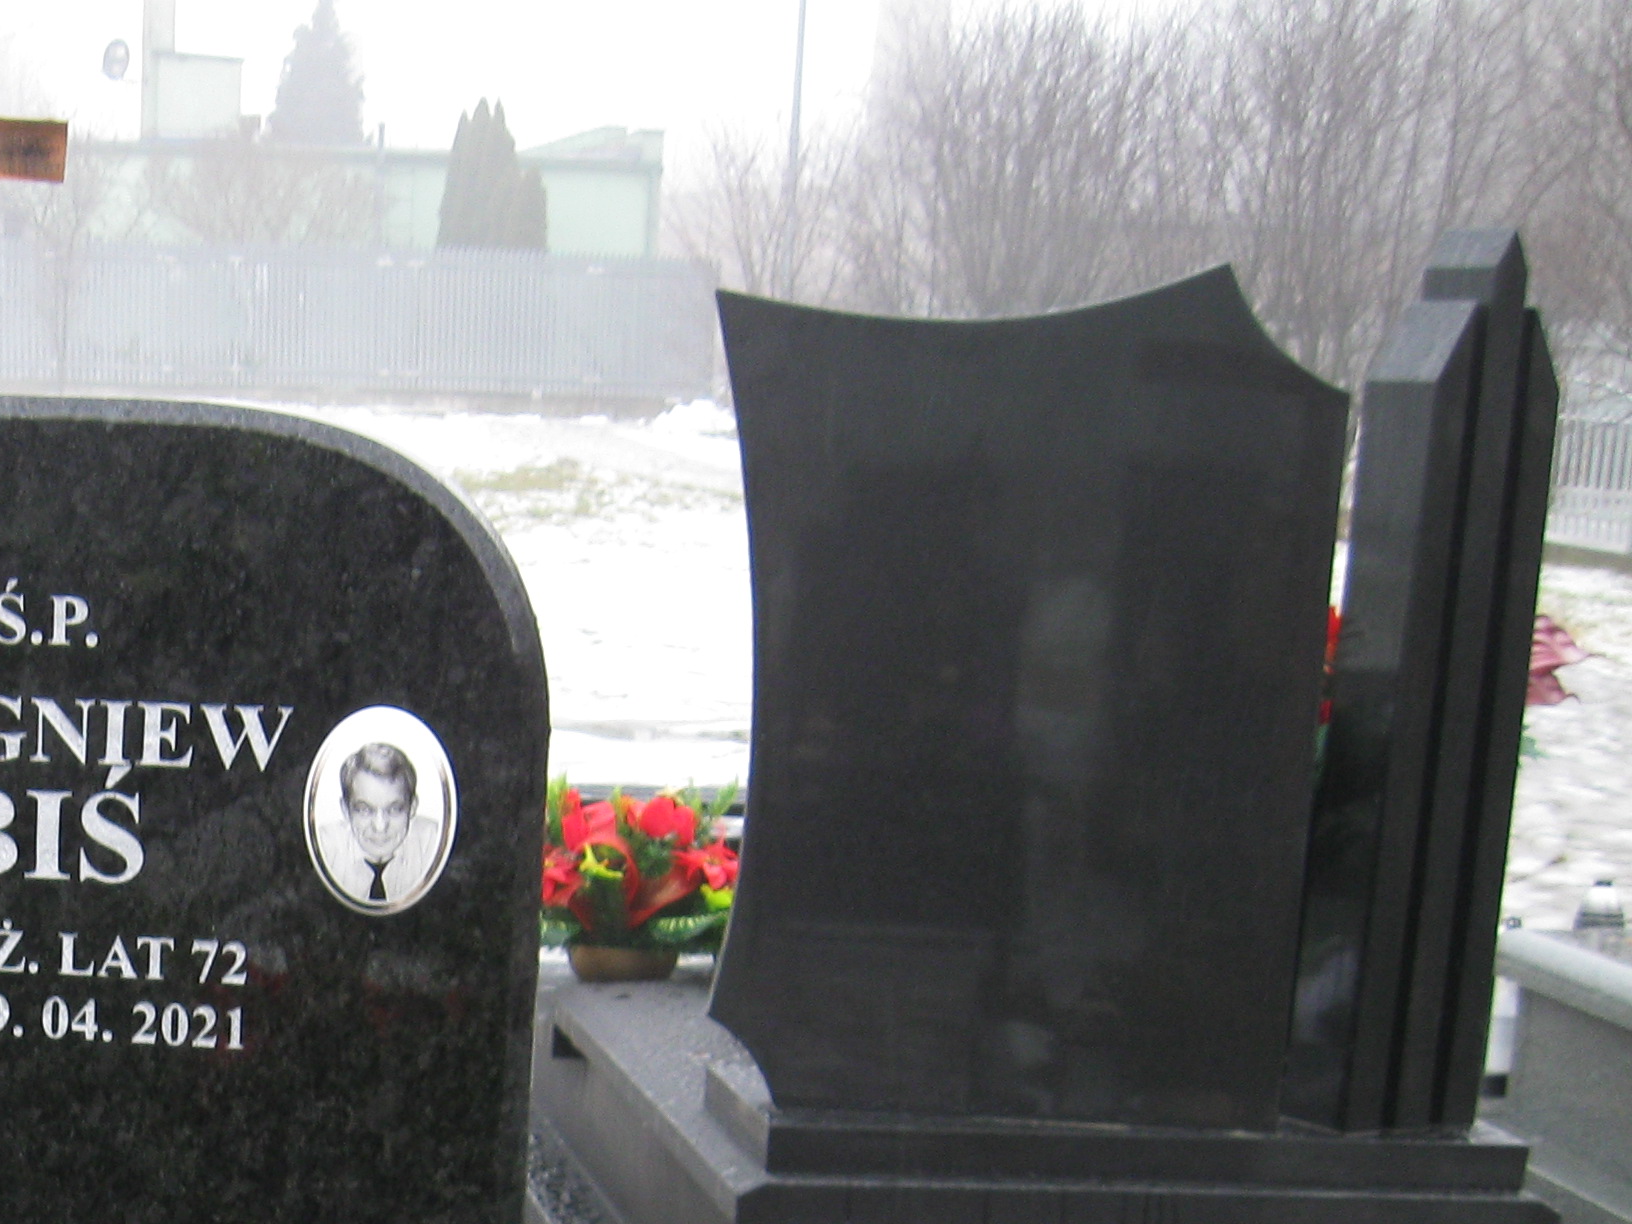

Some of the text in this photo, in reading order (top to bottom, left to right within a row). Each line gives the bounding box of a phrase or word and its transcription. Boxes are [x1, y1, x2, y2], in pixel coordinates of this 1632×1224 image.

[57, 931, 175, 981] LAT
[191, 938, 249, 986] 72
[41, 994, 114, 1043] 04.
[130, 1000, 245, 1050] 2021
